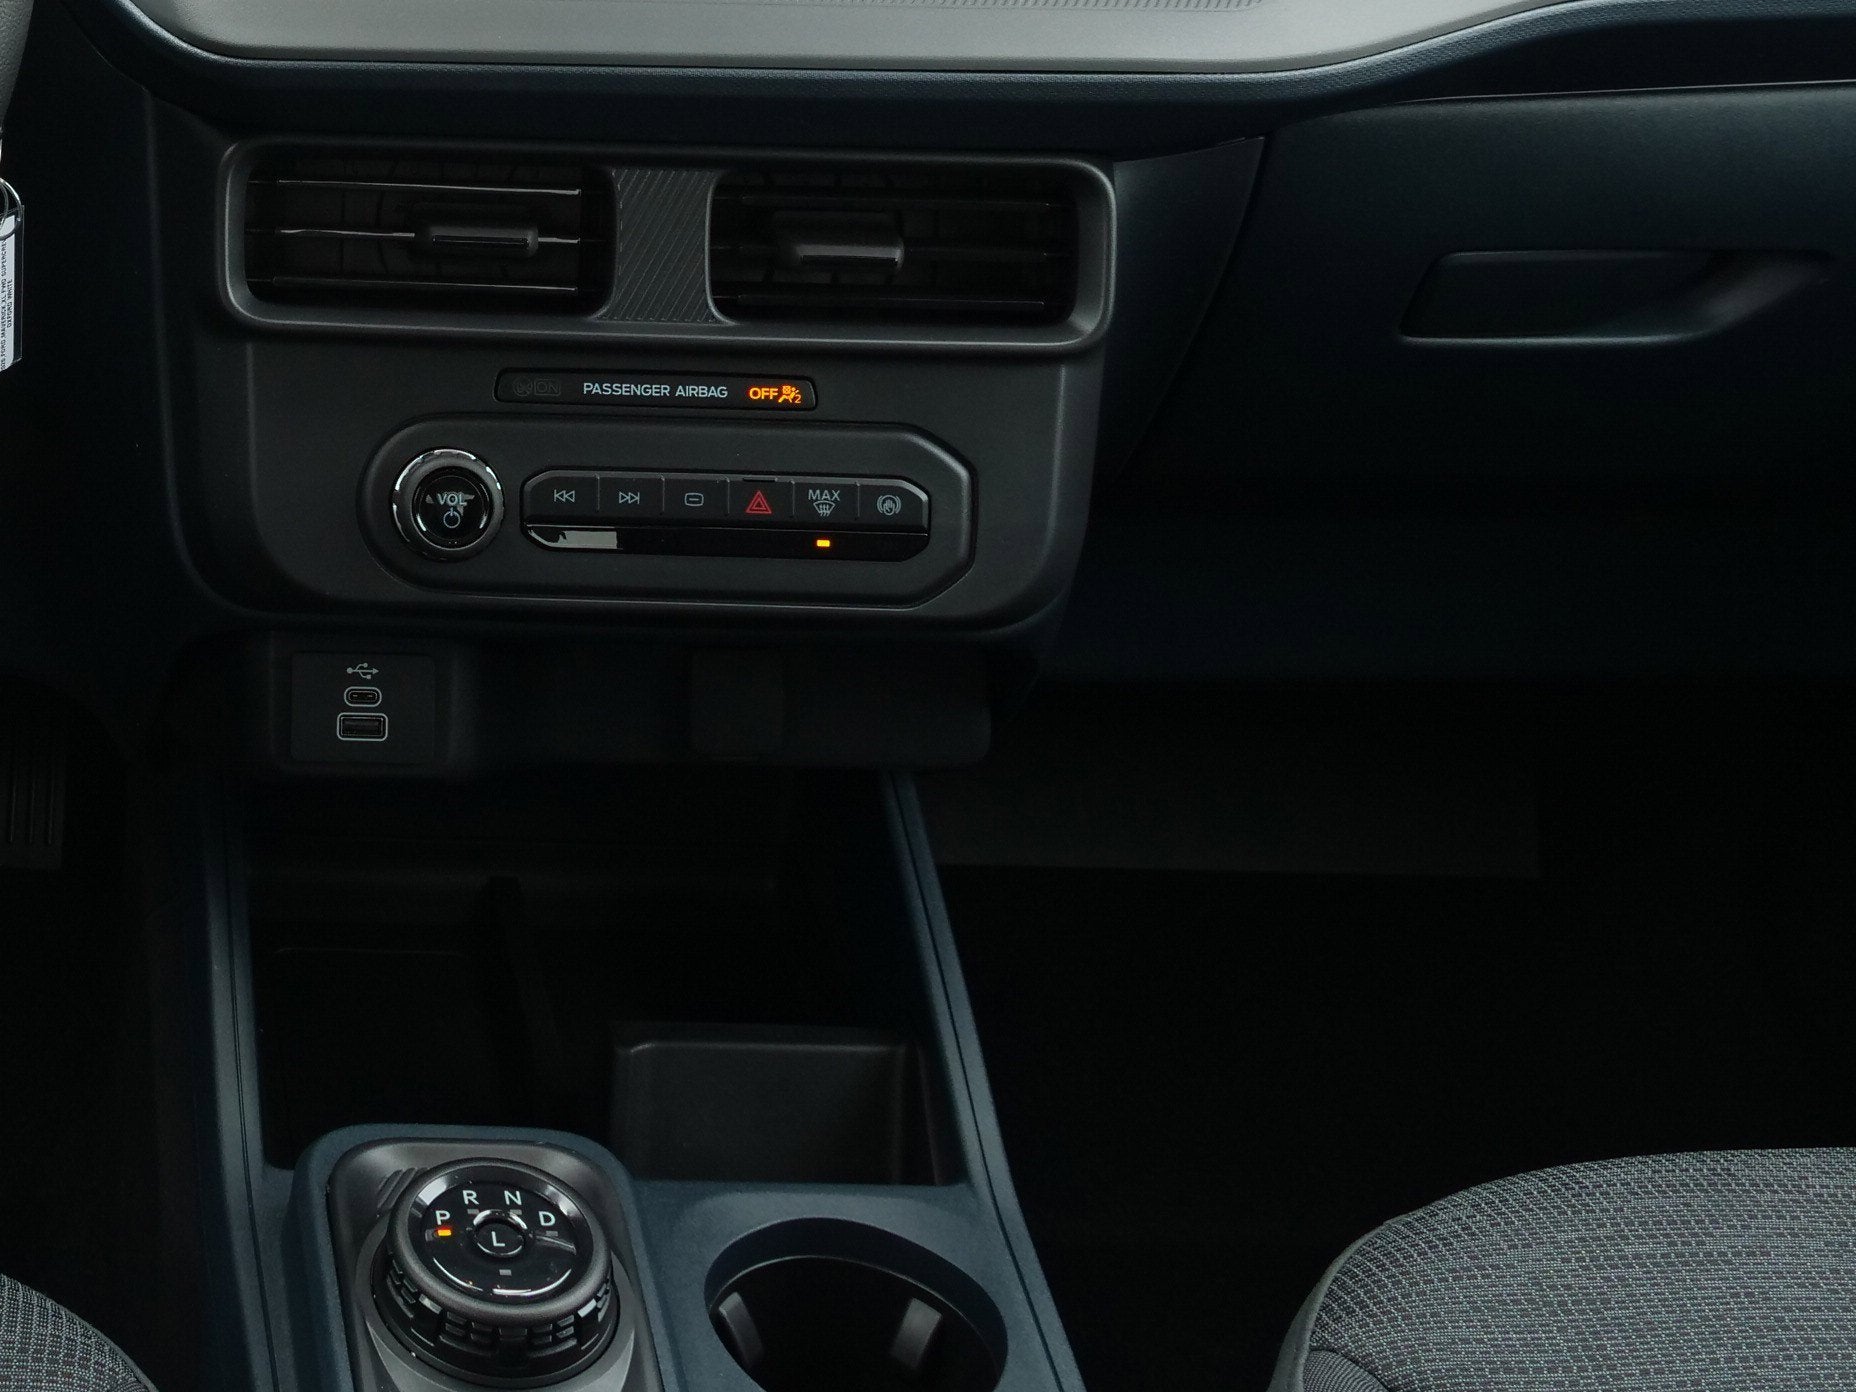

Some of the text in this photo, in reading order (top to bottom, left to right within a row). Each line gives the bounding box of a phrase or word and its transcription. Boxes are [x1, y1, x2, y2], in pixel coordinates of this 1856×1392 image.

[583, 381, 728, 399] PASSENGER AIRBAG
[749, 387, 779, 400] OFF
[436, 492, 467, 506] VOL
[808, 489, 841, 501] MAX
[435, 1190, 556, 1226] P R N D
[491, 1231, 506, 1247] L
